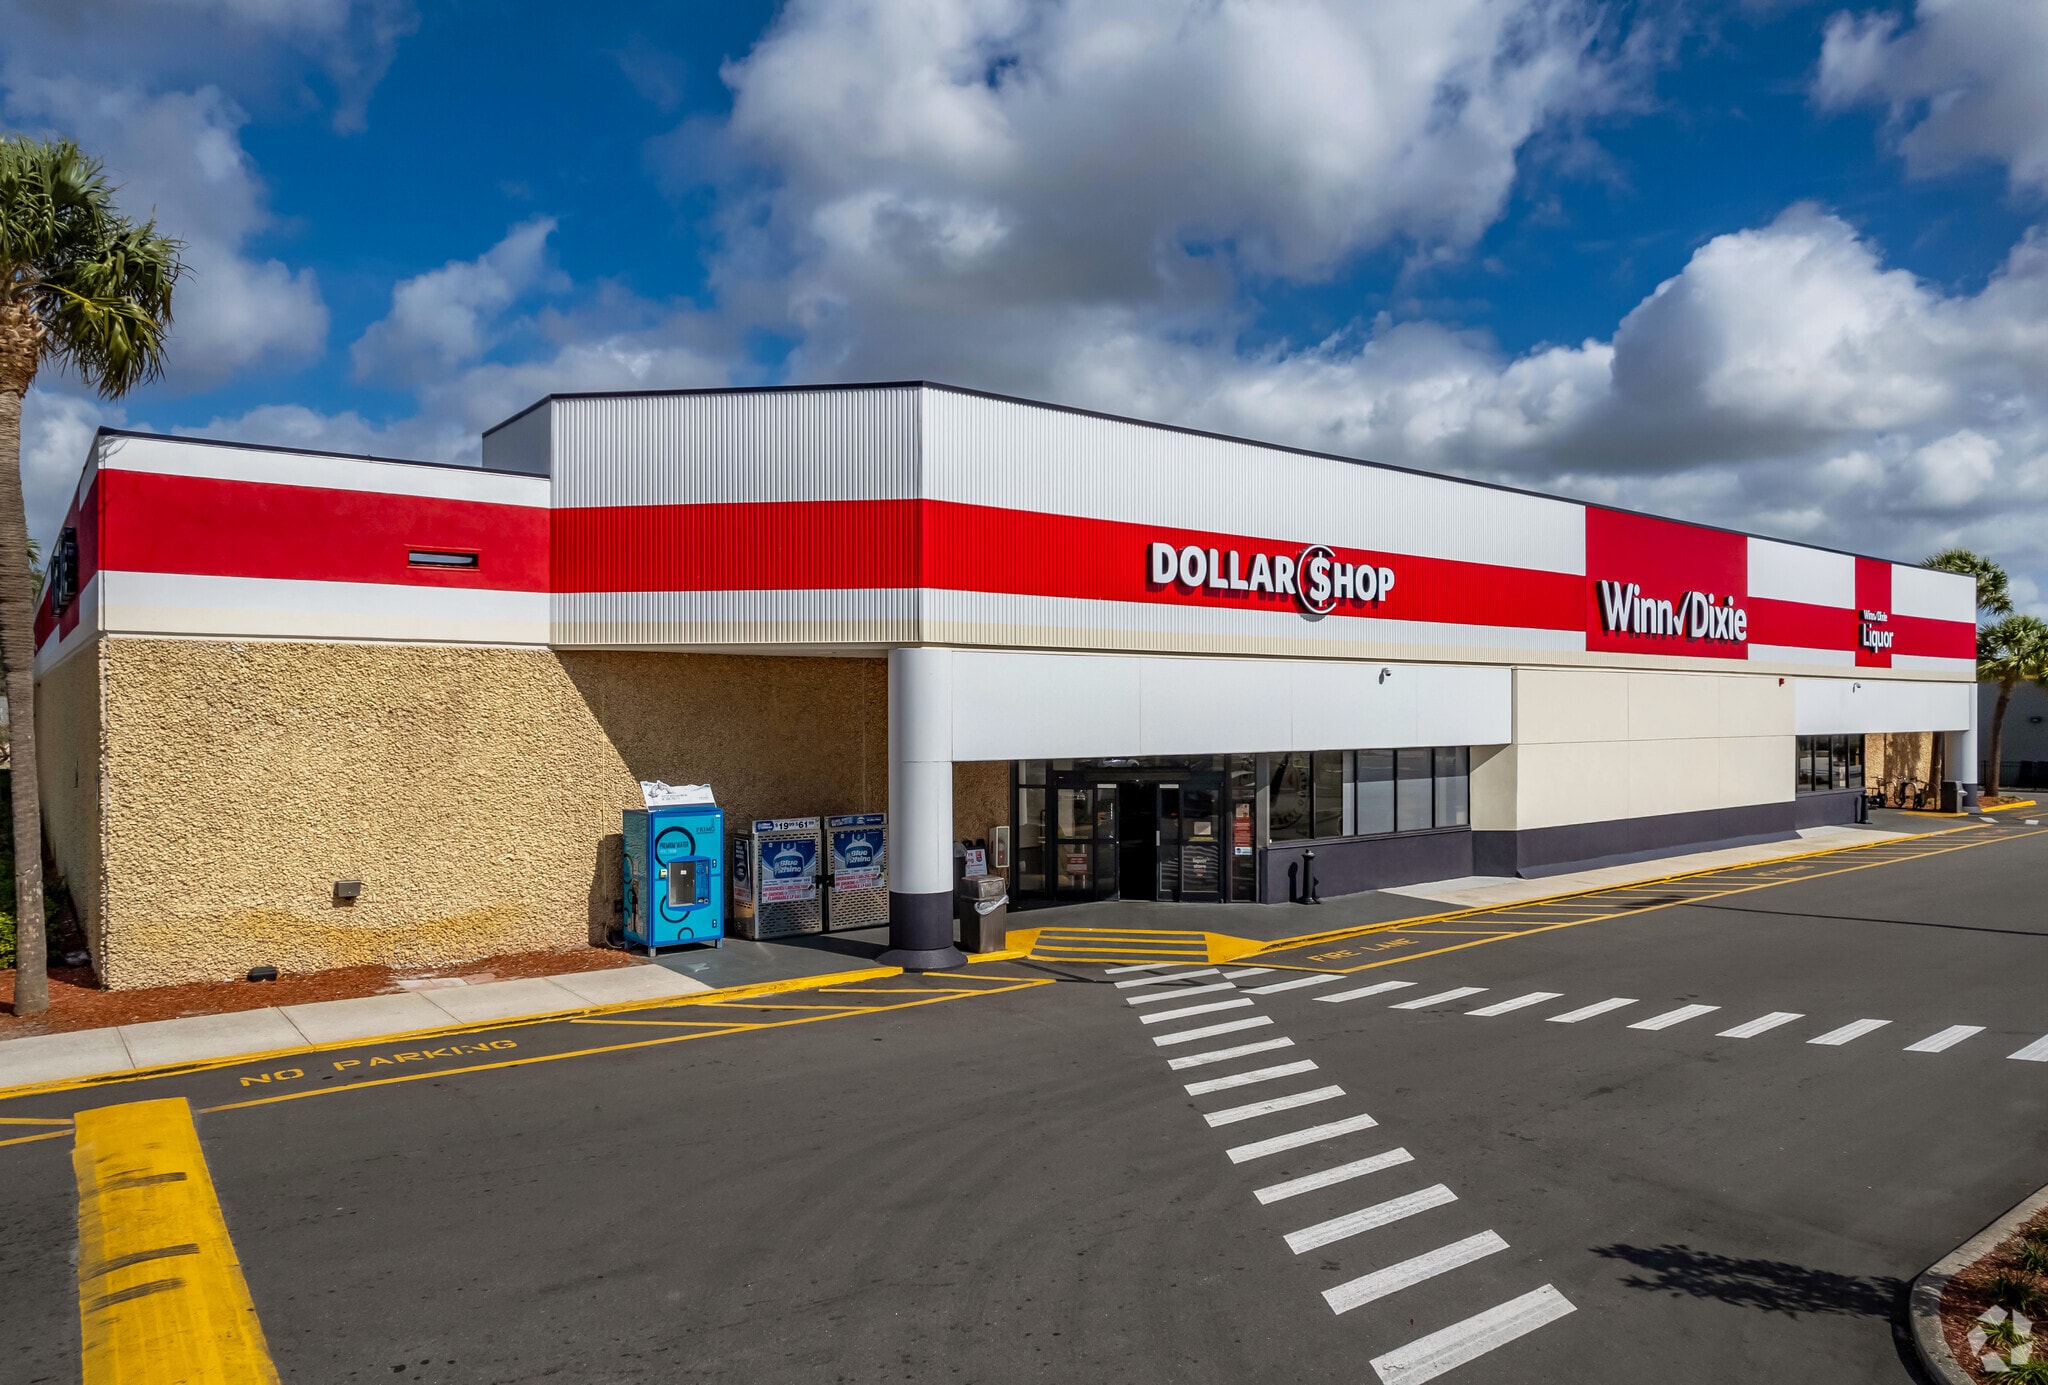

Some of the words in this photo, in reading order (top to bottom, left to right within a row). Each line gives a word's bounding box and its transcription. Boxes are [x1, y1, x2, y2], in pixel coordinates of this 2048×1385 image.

[1152, 541, 1297, 595] DOLLAR
[1601, 579, 1674, 635] Winn
[1690, 591, 1748, 641] Dixie
[1863, 623, 1894, 653] Liquor
[696, 825, 715, 833] PRIMO
[1306, 949, 1362, 962] FIRE
[1360, 938, 1420, 952] LANE
[239, 1068, 305, 1087] NO
[332, 1039, 518, 1071] PARKING
